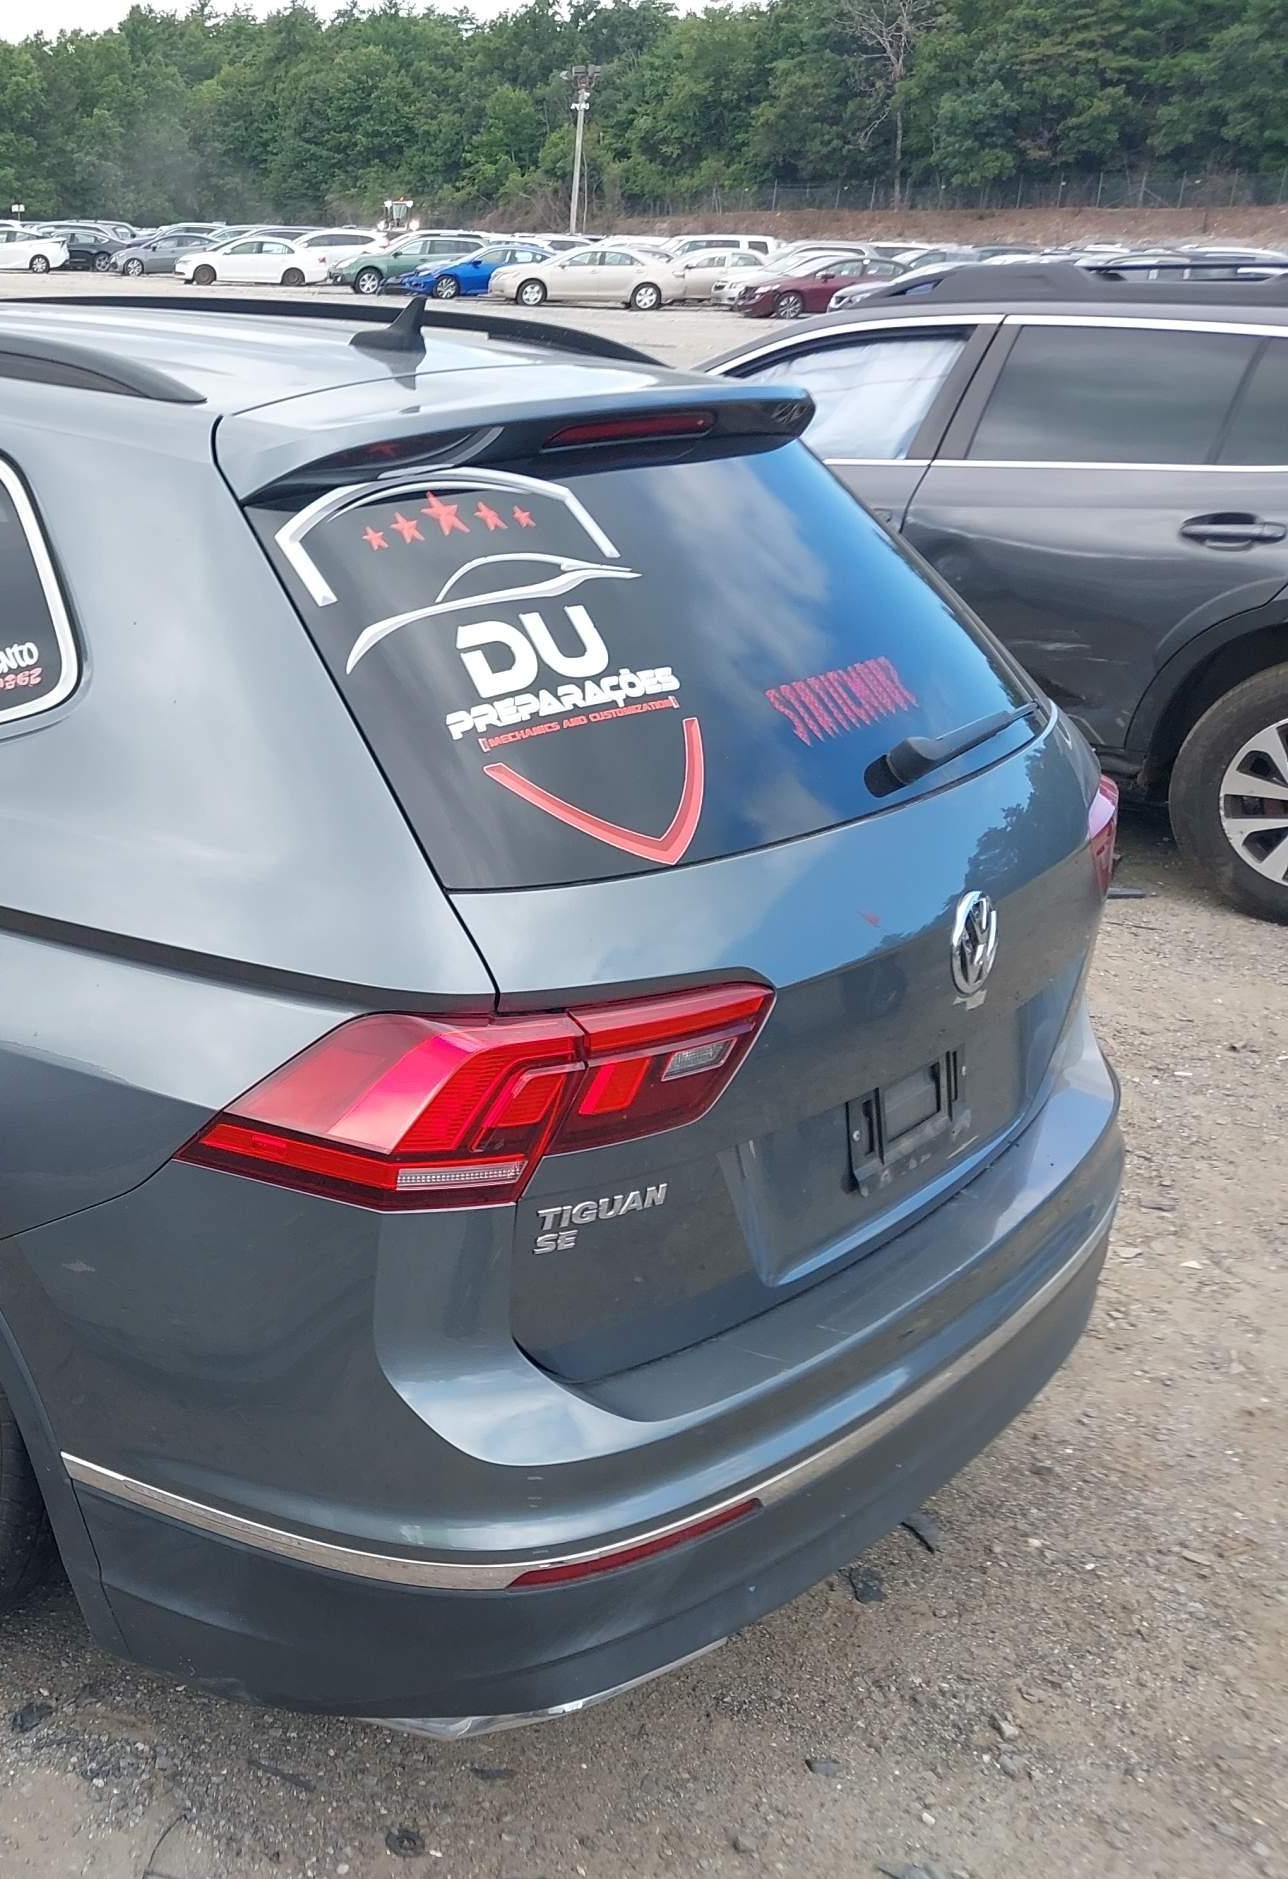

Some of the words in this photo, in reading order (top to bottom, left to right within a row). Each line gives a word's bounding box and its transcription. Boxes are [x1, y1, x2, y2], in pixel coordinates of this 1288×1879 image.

[455, 604, 609, 699] DU
[446, 666, 680, 741] PREPARAÇÕES
[537, 1183, 668, 1231] TIGUAN
[532, 1229, 578, 1255] SE
